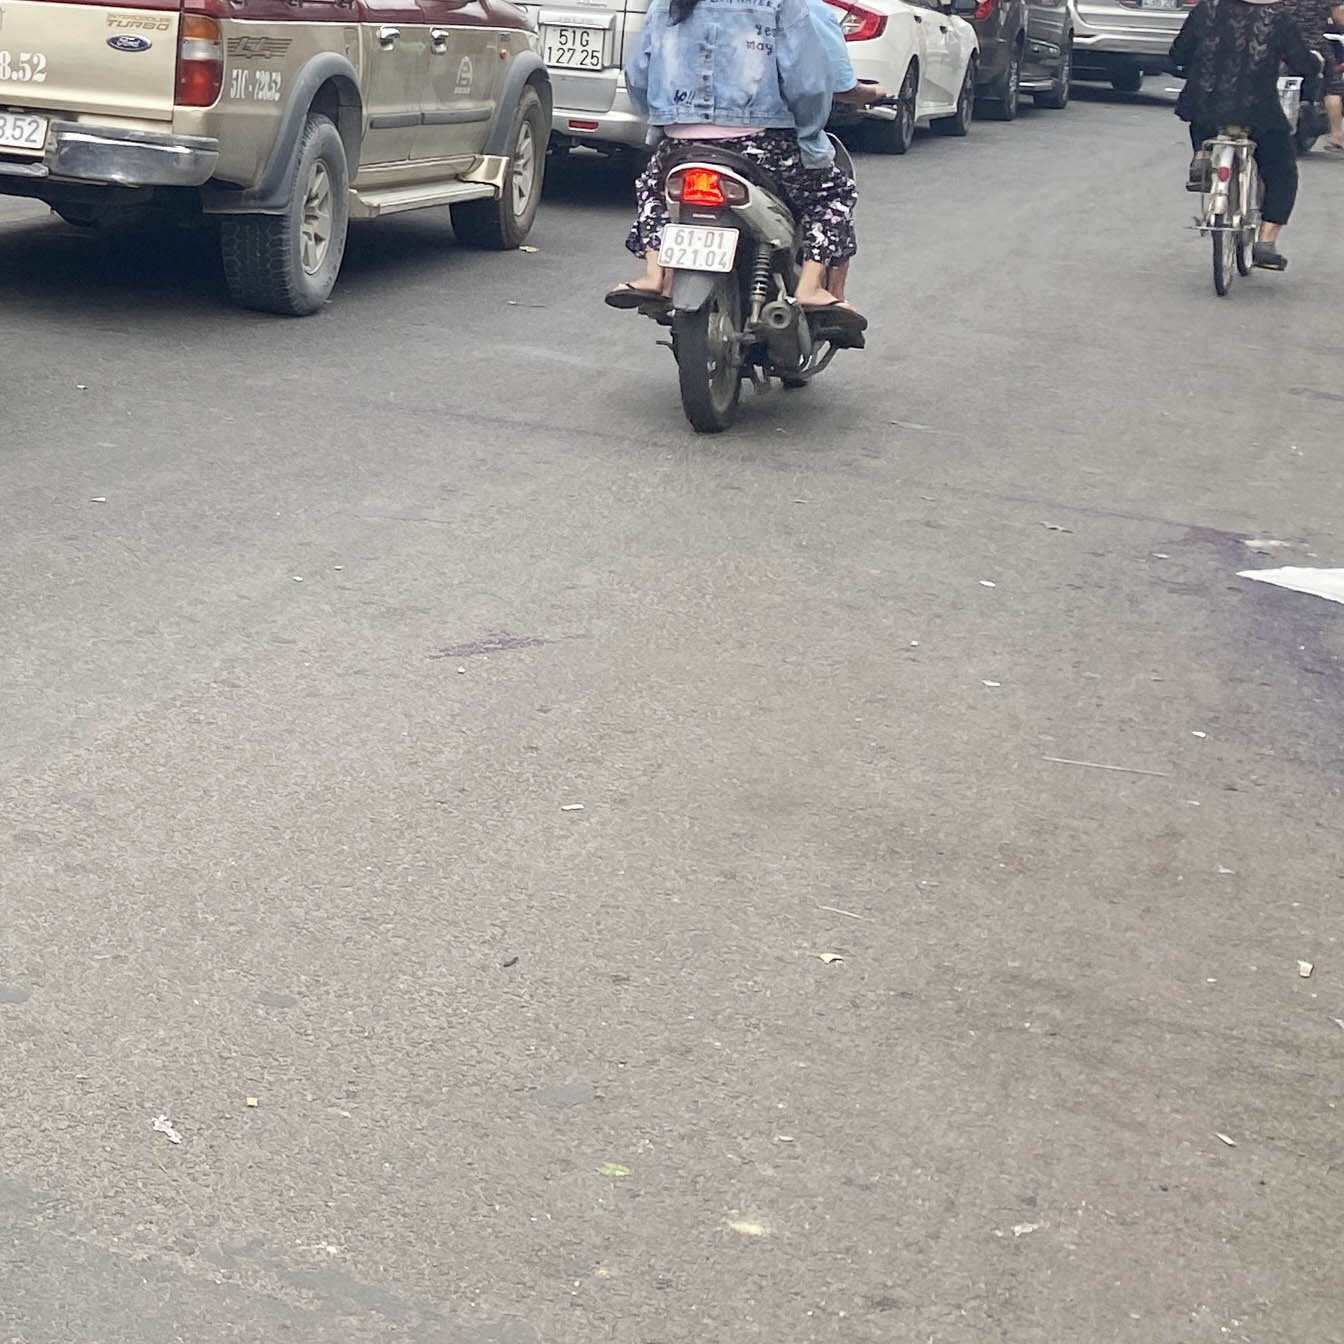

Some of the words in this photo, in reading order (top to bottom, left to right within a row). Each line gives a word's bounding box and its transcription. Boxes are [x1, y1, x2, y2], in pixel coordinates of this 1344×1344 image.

[107, 19, 170, 31] TURBO
[558, 29, 590, 47] 51G
[674, 229, 725, 249] 61-D1
[663, 247, 728, 269] 921.04
